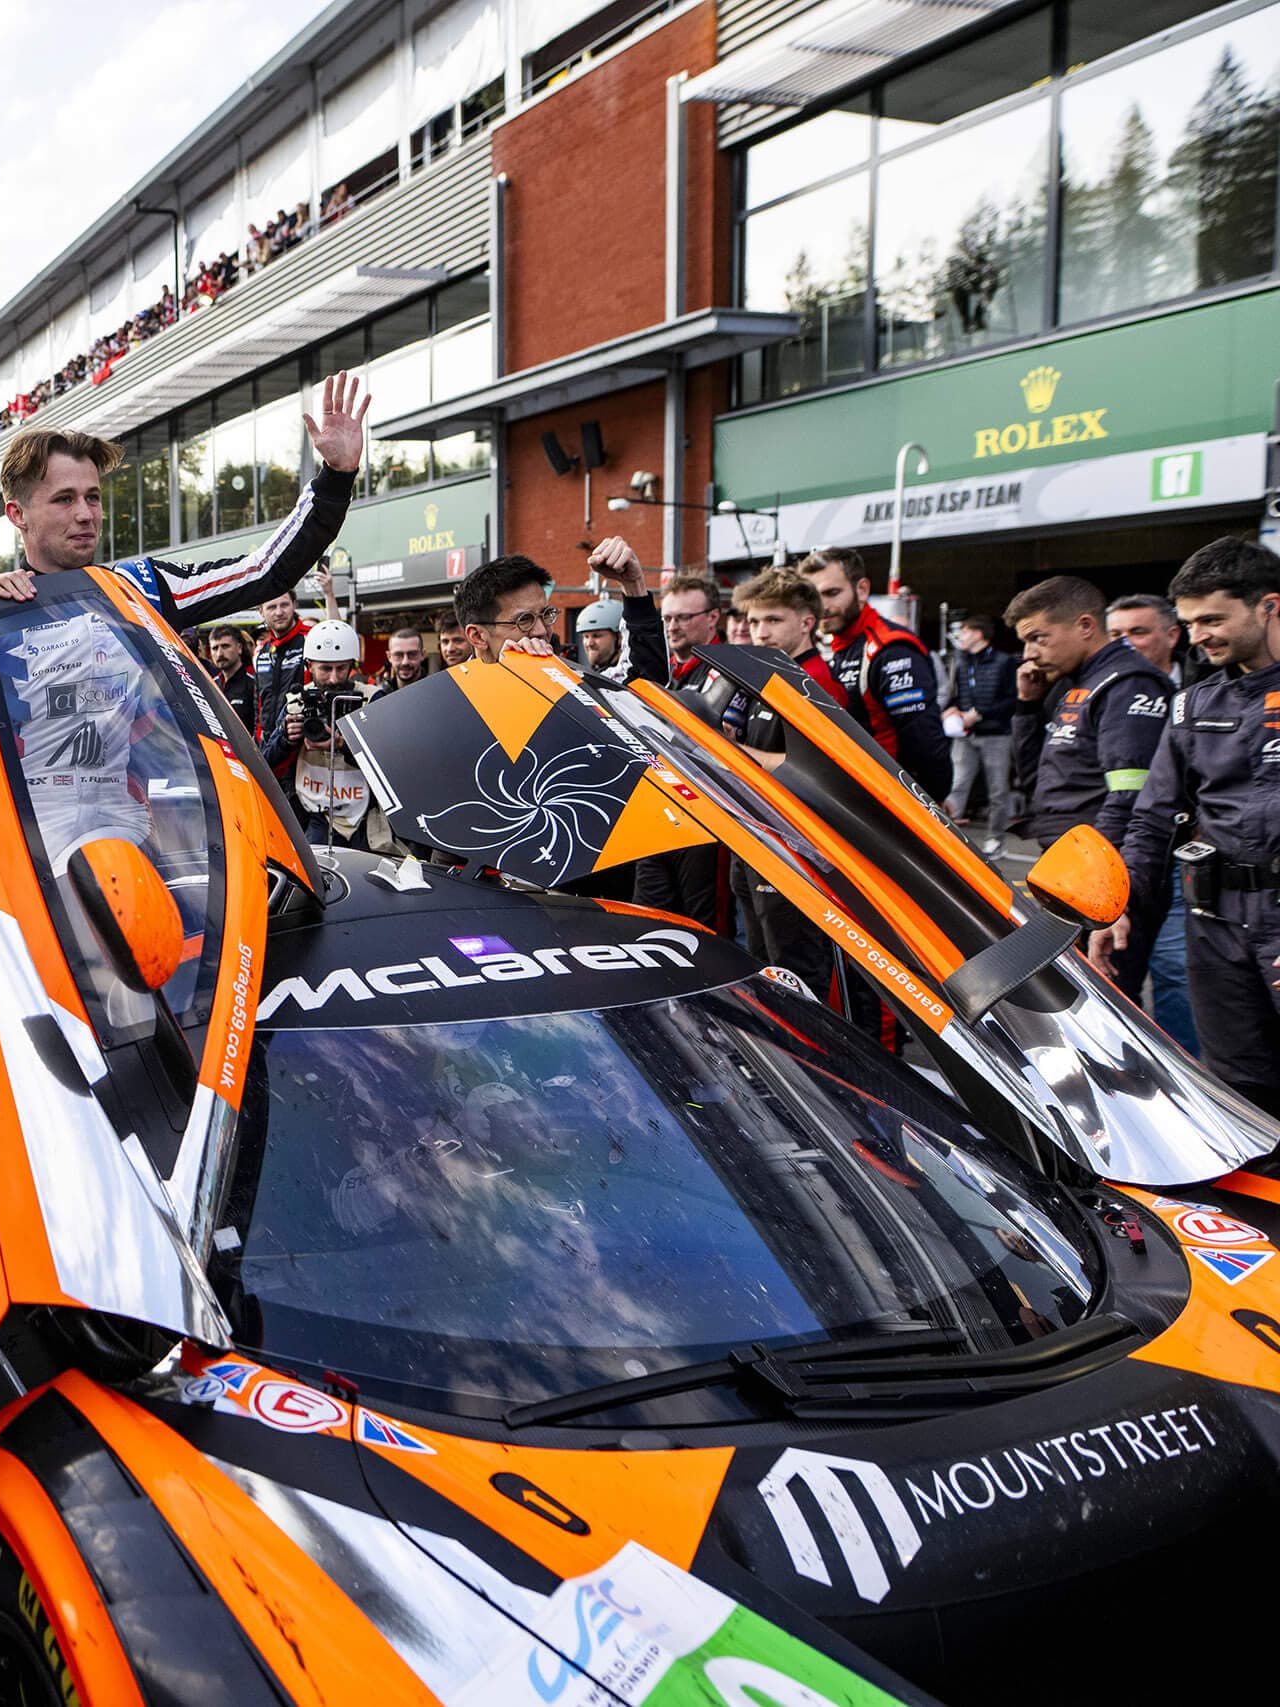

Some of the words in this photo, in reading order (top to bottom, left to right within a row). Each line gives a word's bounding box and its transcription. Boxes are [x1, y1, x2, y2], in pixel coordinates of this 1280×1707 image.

[973, 408, 1109, 459] ROLEX
[863, 492, 932, 523] AKKDIS
[936, 488, 970, 514] ASP
[975, 482, 1022, 509] TEAM
[408, 530, 455, 556] ROLEX
[450, 551, 462, 577] 7
[32, 661, 83, 677] GOODYEAR
[303, 775, 324, 794] PIT
[256, 930, 699, 1022] McLaren
[822, 909, 945, 1017] garage59.co.uk
[220, 942, 253, 1090] garage59.co.uk
[905, 1403, 1219, 1525] MOUNTSTREET
